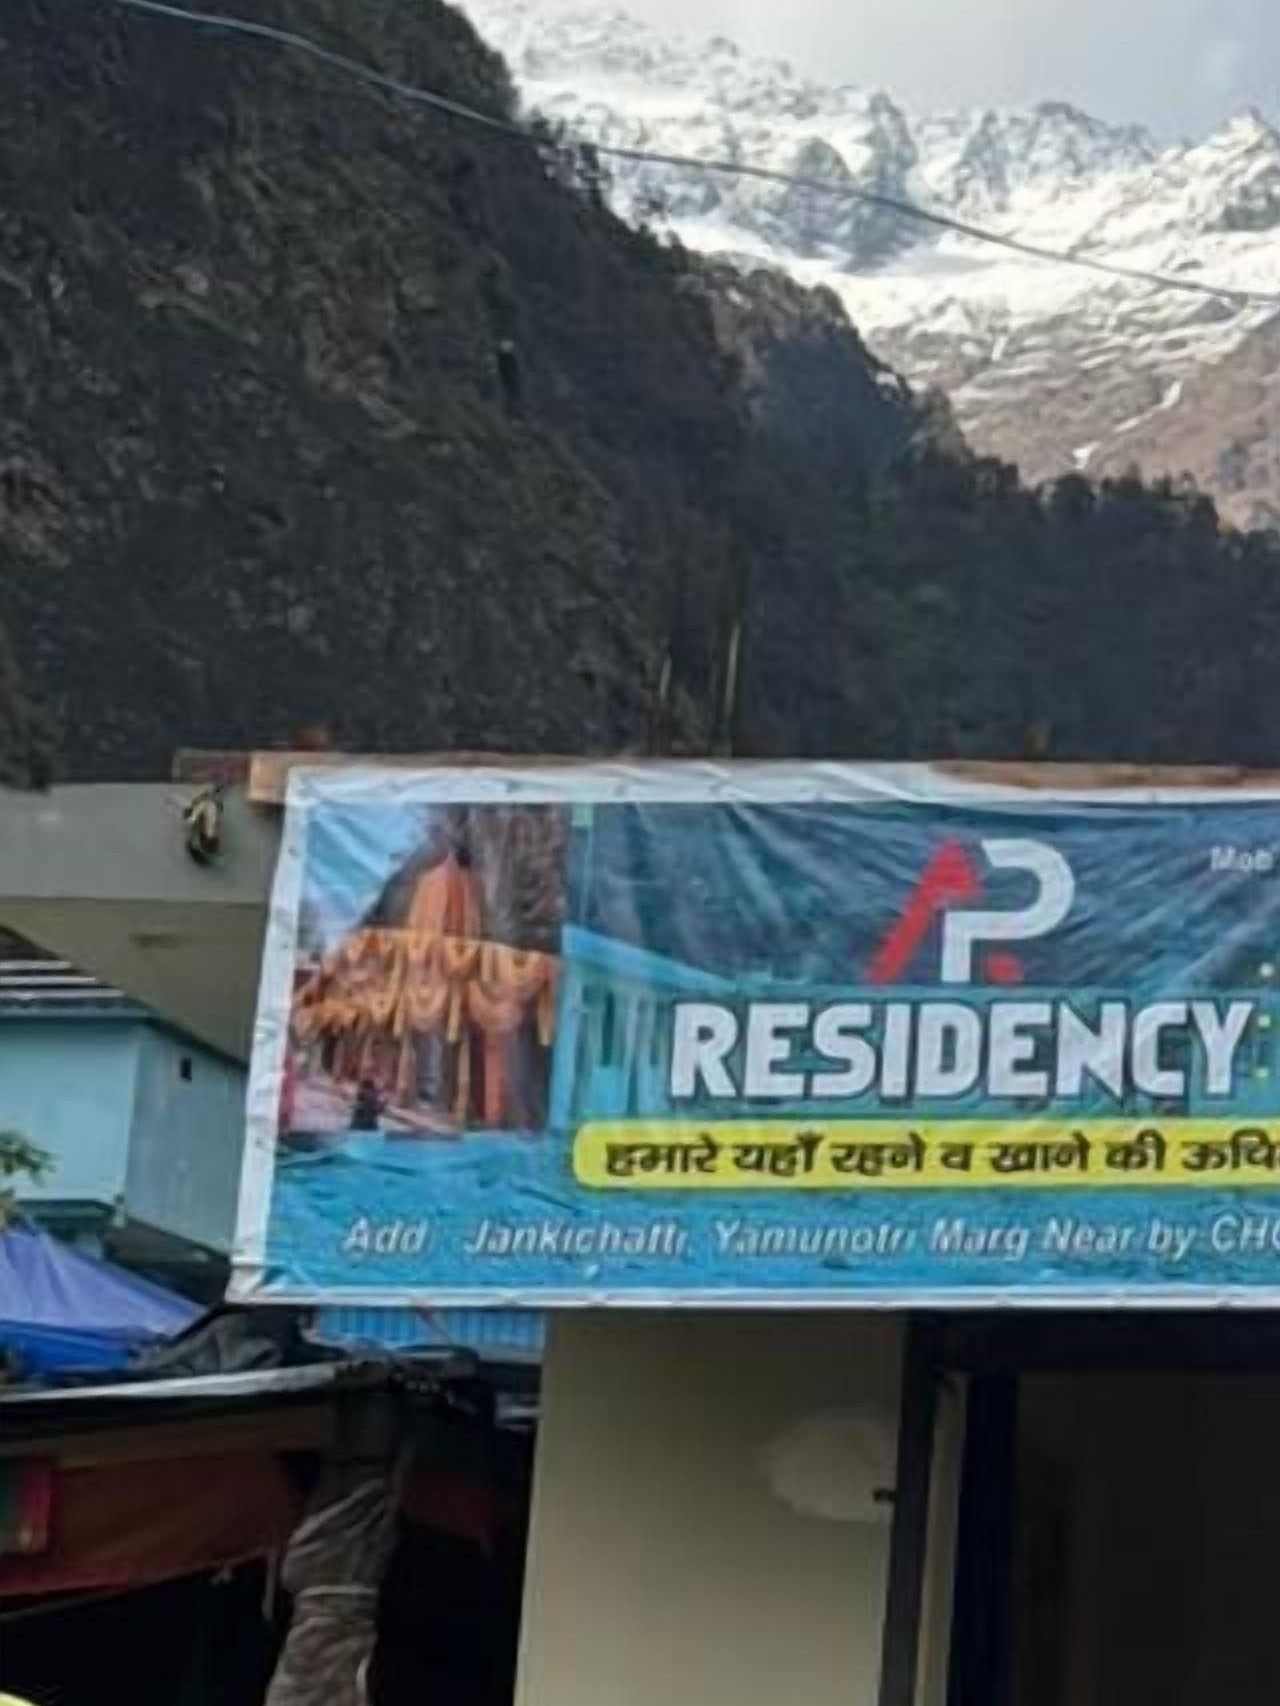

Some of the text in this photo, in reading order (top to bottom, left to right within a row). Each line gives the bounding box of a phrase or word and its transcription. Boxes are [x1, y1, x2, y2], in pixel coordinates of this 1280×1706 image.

[670, 1000, 1254, 1098] RESIDENCY
[605, 1132, 719, 1176] हमारे
[830, 1130, 928, 1176] रहने
[941, 1141, 973, 1172] व
[988, 1131, 1092, 1172] खाने
[1103, 1129, 1167, 1171] की
[931, 1218, 1030, 1262] Marg
[1042, 1217, 1134, 1254] Near
[1148, 1215, 1196, 1262] by
